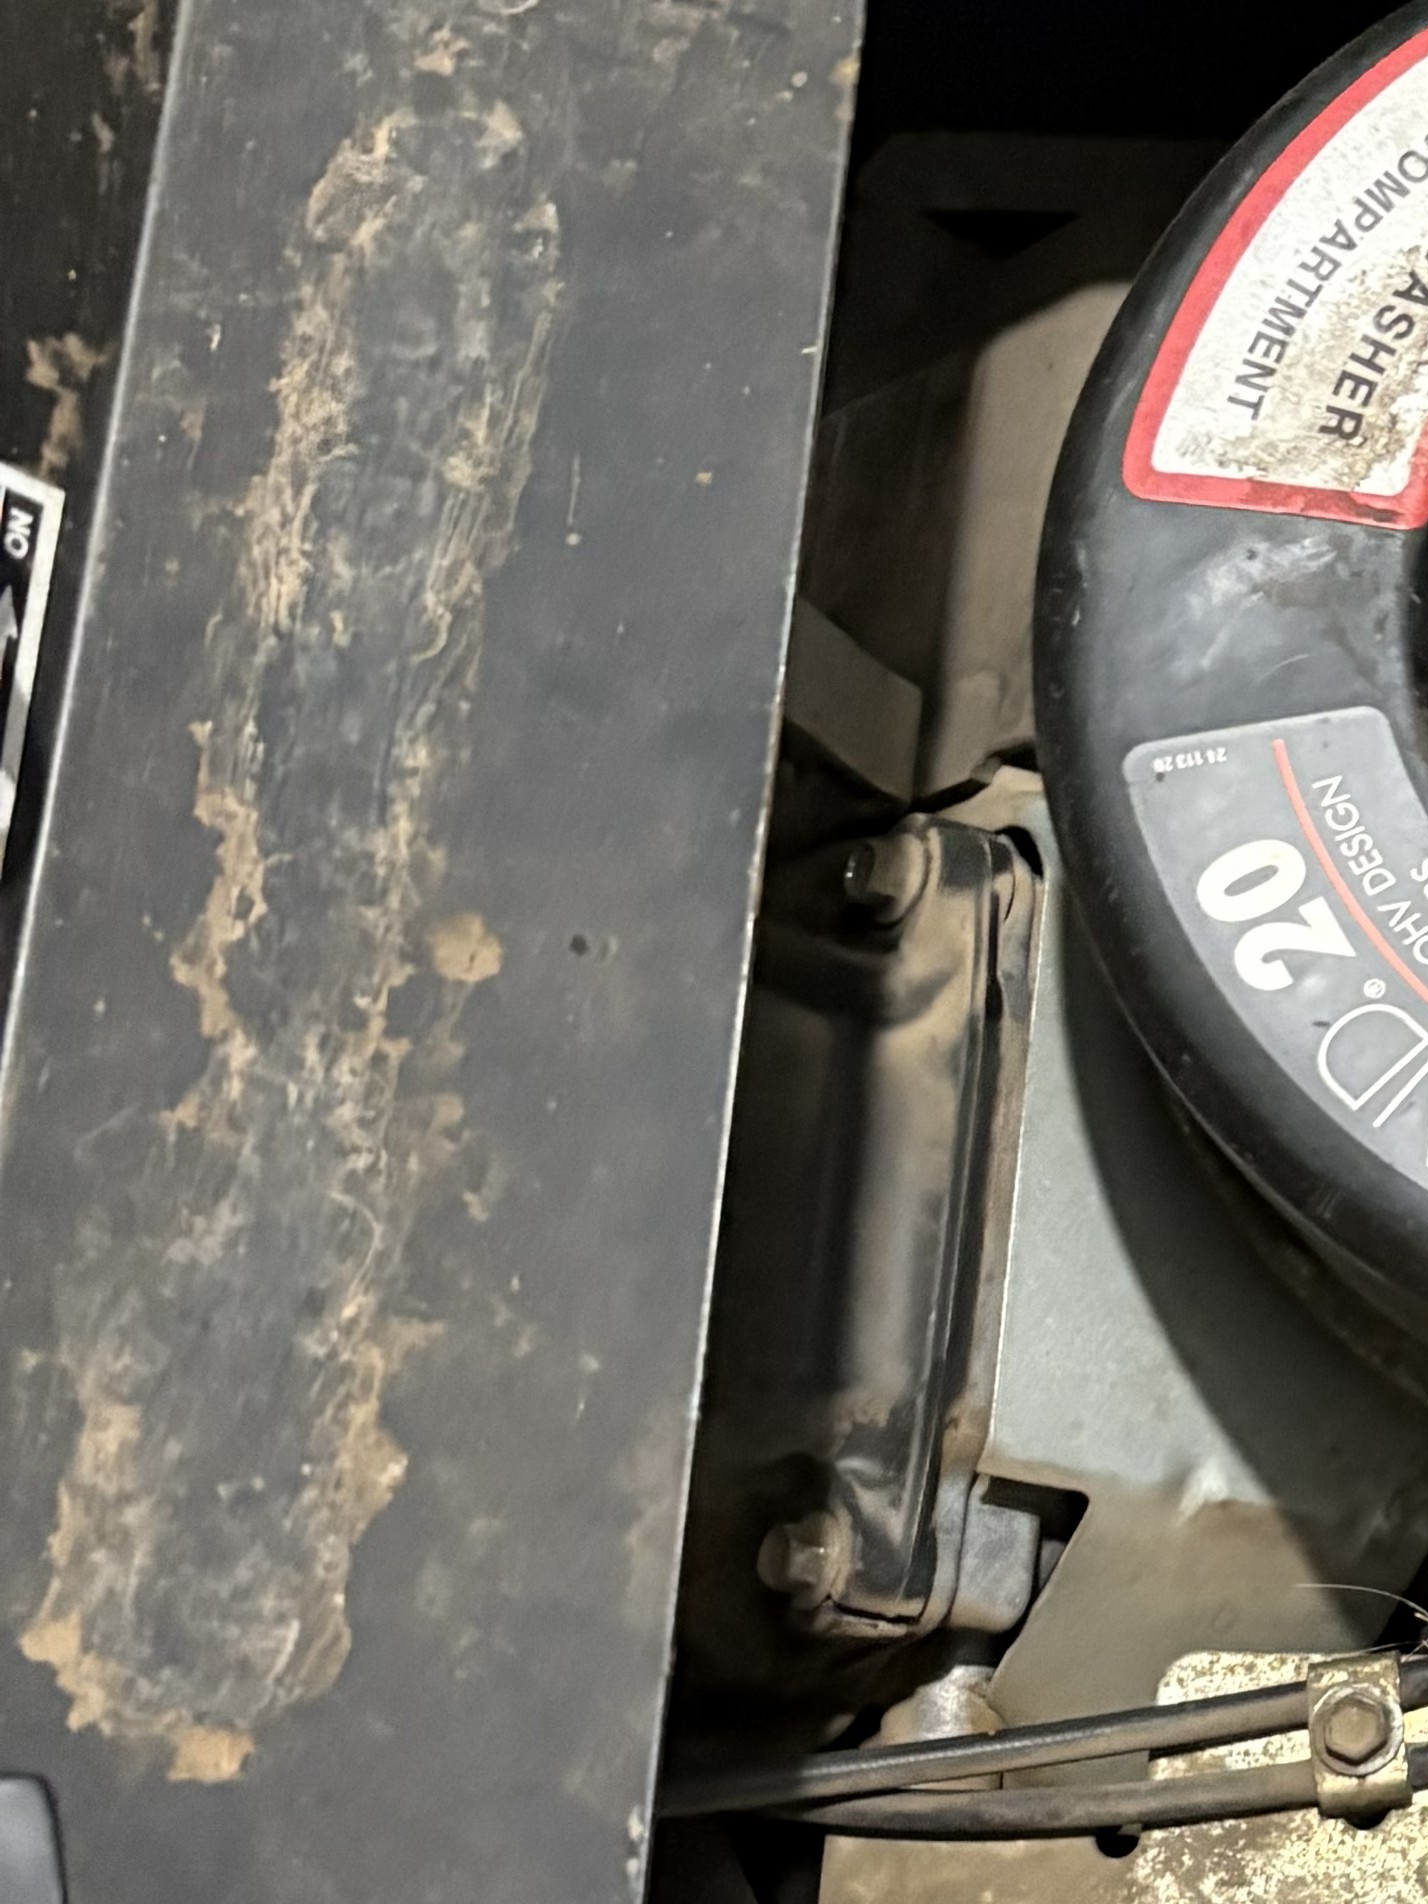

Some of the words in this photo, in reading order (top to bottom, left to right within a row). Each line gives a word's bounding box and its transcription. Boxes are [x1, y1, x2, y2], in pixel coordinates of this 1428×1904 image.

[4, 507, 34, 559] ON
[1311, 774, 1397, 899] DESIGN
[1196, 838, 1358, 993] 20
